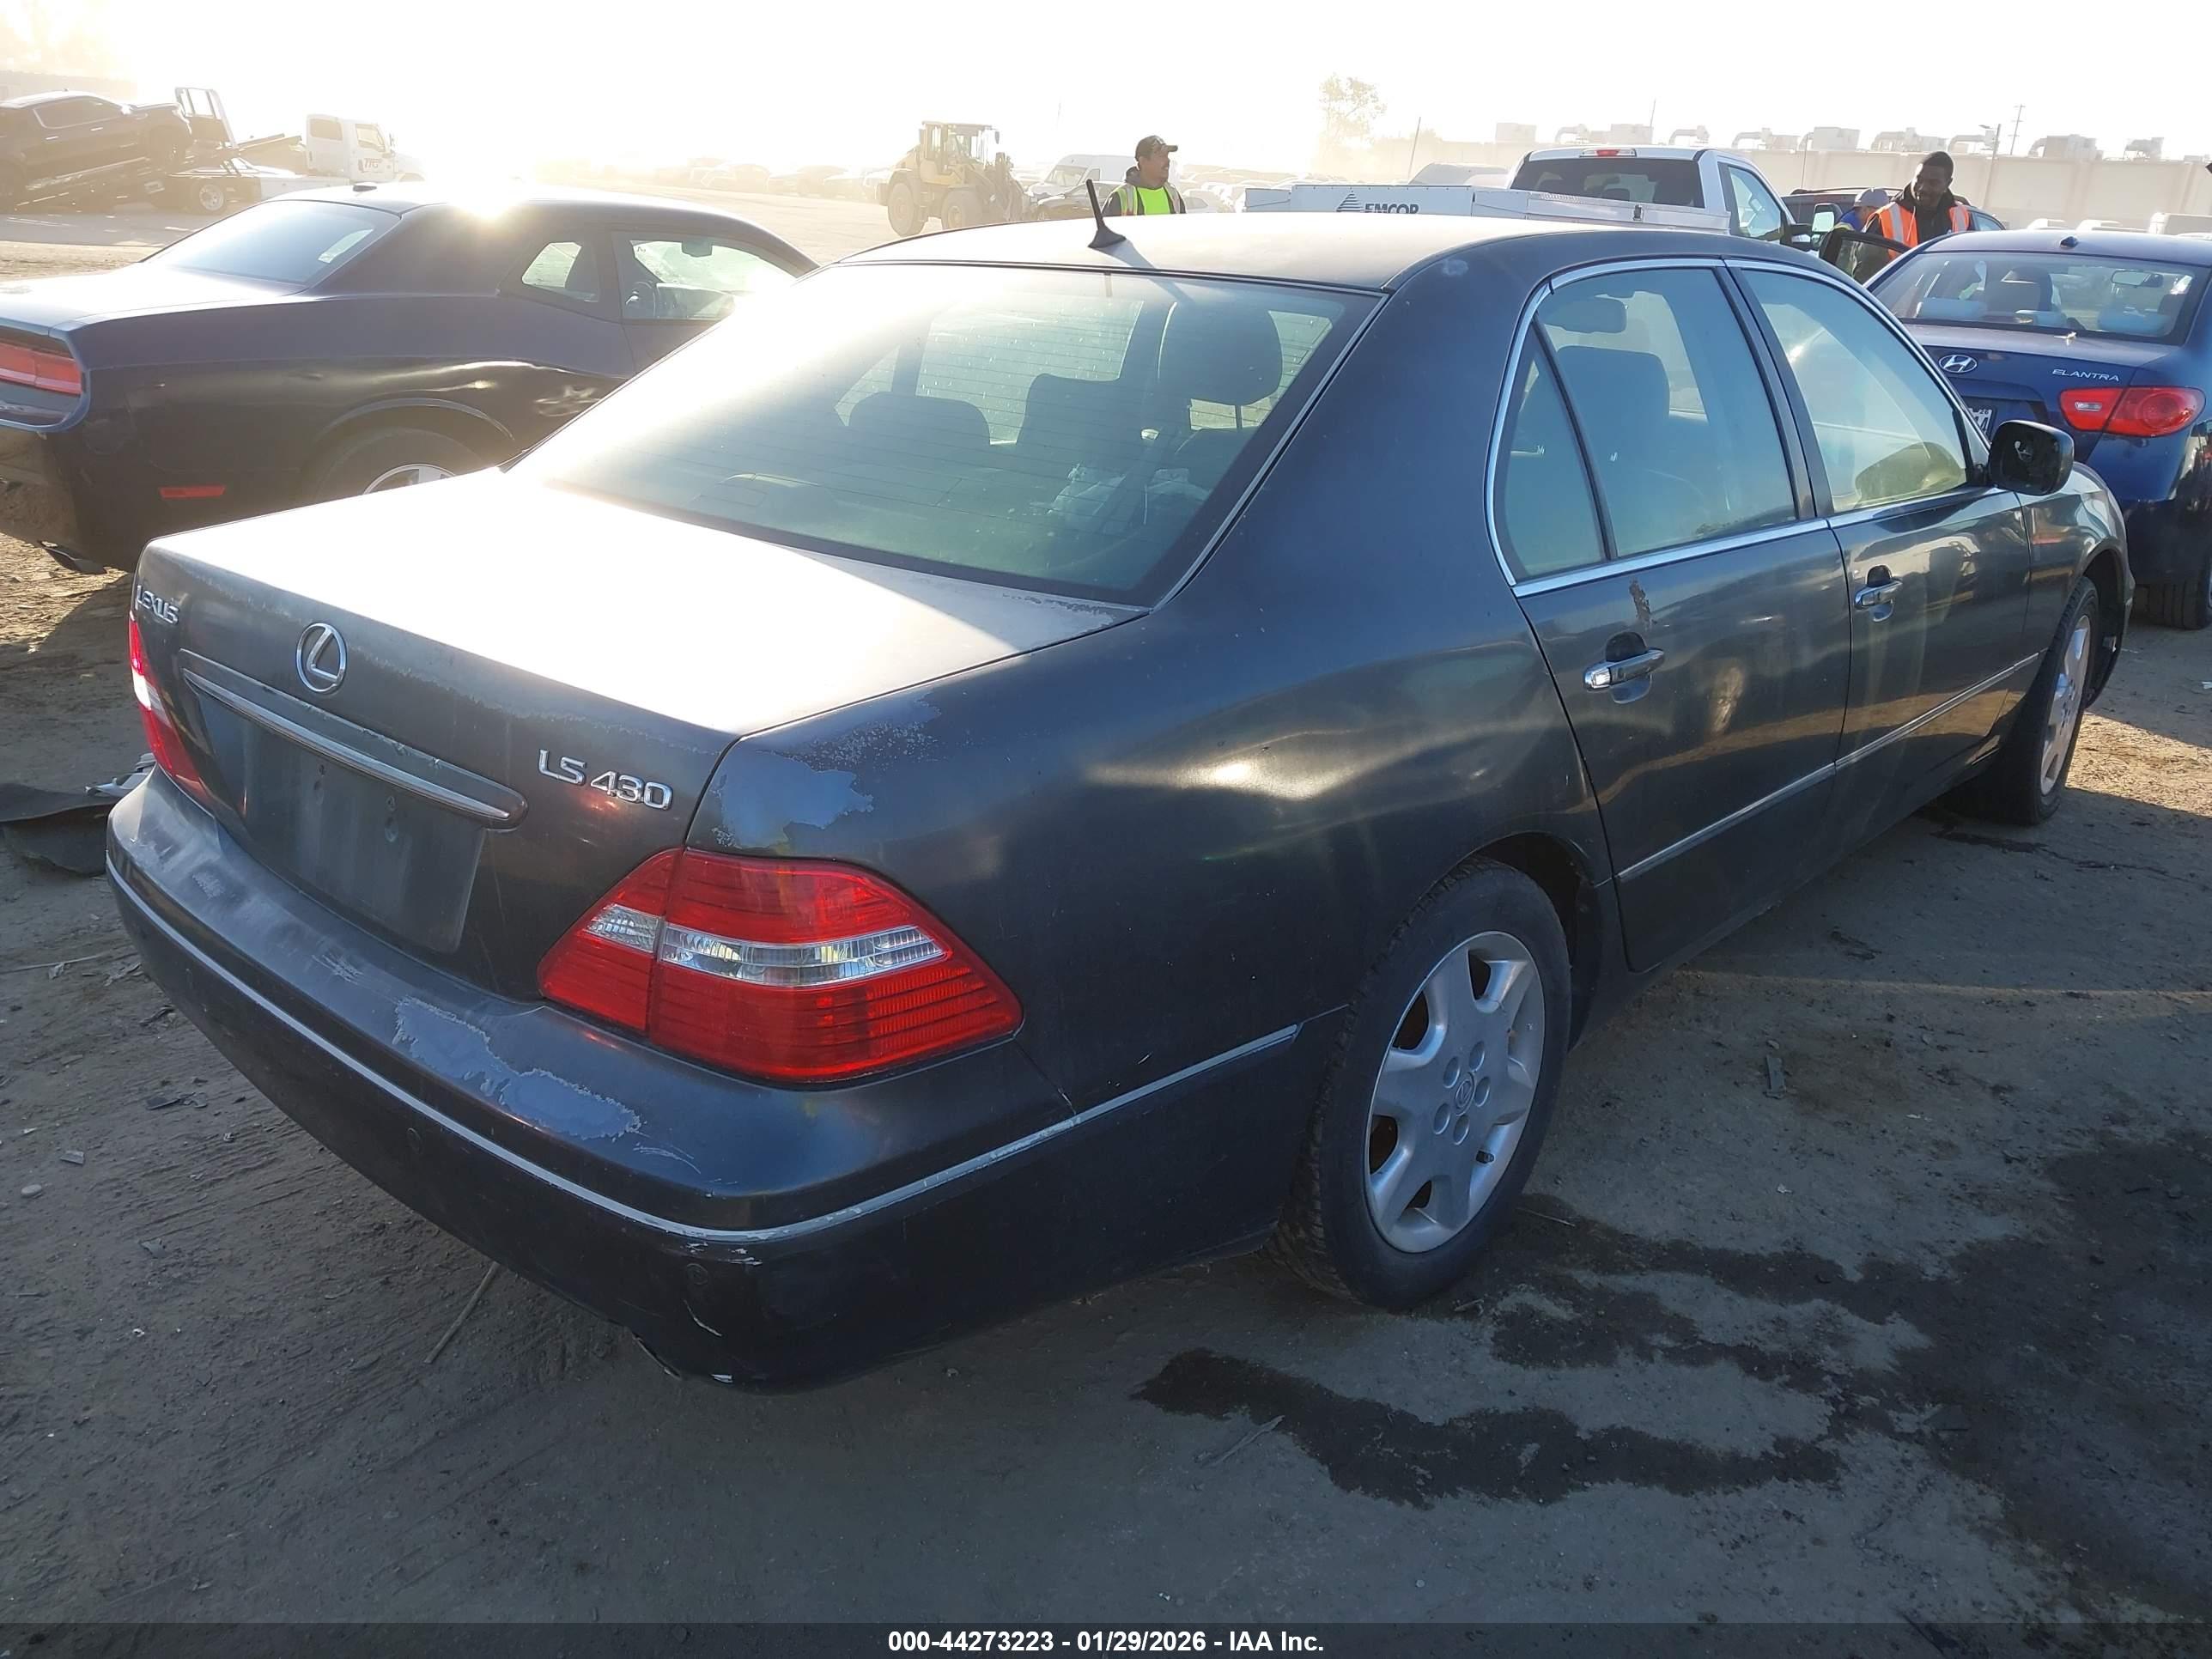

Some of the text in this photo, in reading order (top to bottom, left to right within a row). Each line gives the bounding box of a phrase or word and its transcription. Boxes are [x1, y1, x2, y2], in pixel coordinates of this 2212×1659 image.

[2052, 368, 2119, 381] ELANTRA
[137, 585, 179, 624] LEXUS
[538, 749, 673, 811] LS 430
